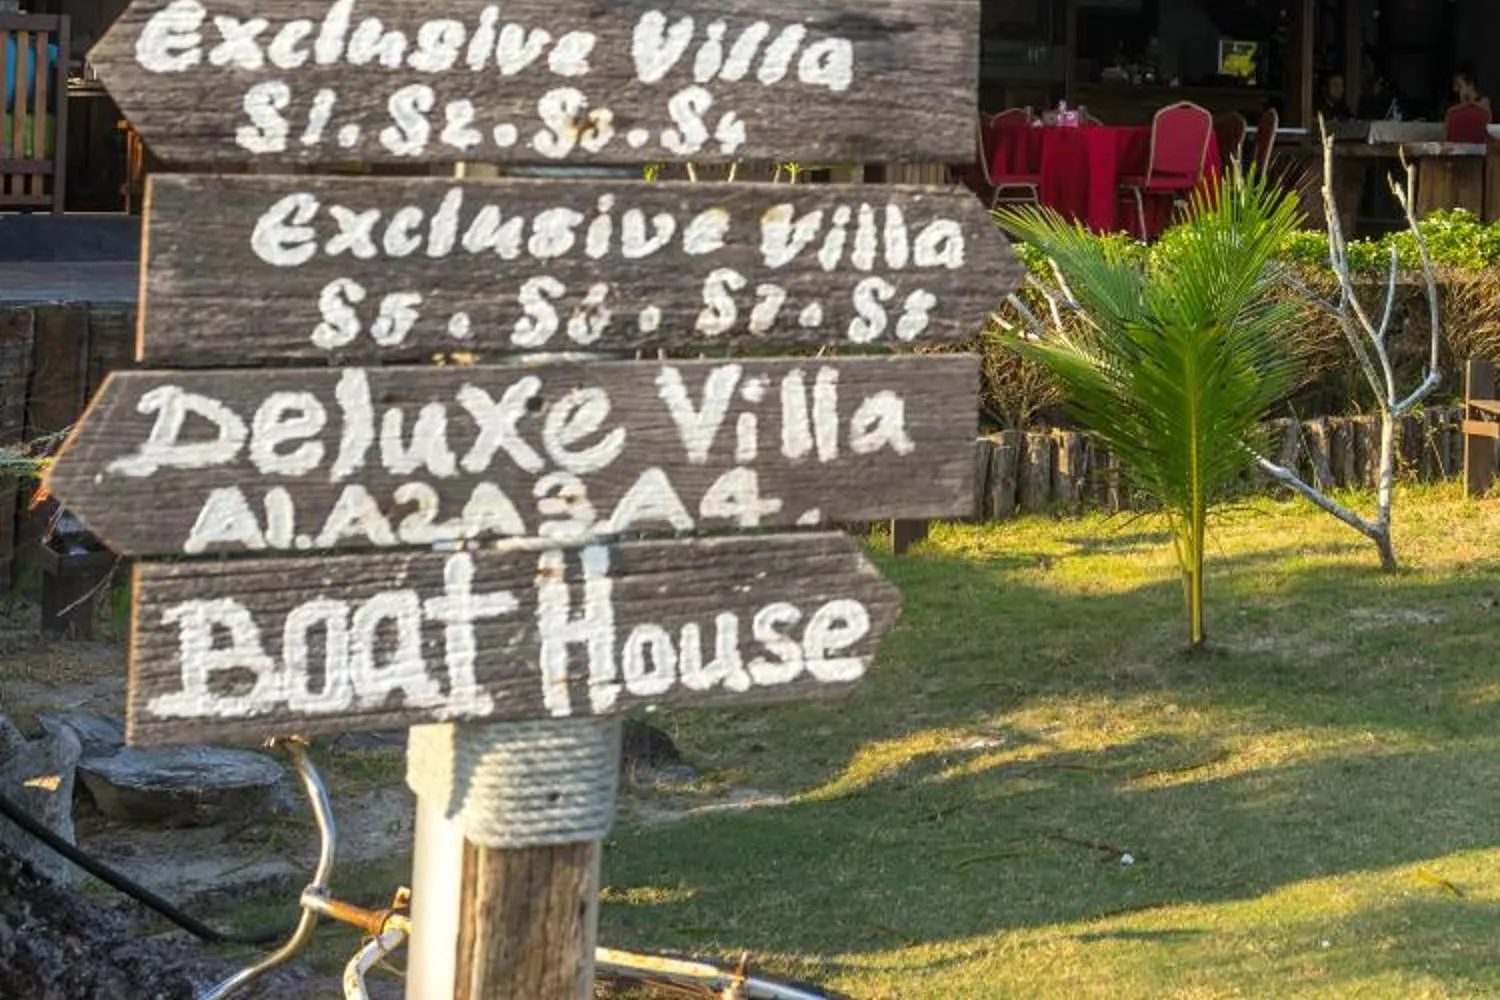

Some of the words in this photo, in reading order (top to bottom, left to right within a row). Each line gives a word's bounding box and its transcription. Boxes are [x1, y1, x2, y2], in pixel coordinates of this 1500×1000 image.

[631, 9, 855, 92] Villa
[251, 188, 732, 267] Exclusive
[760, 202, 966, 271] Villa
[94, 366, 626, 484] Deluxe
[655, 364, 917, 465] Villa
[537, 545, 872, 717] House
